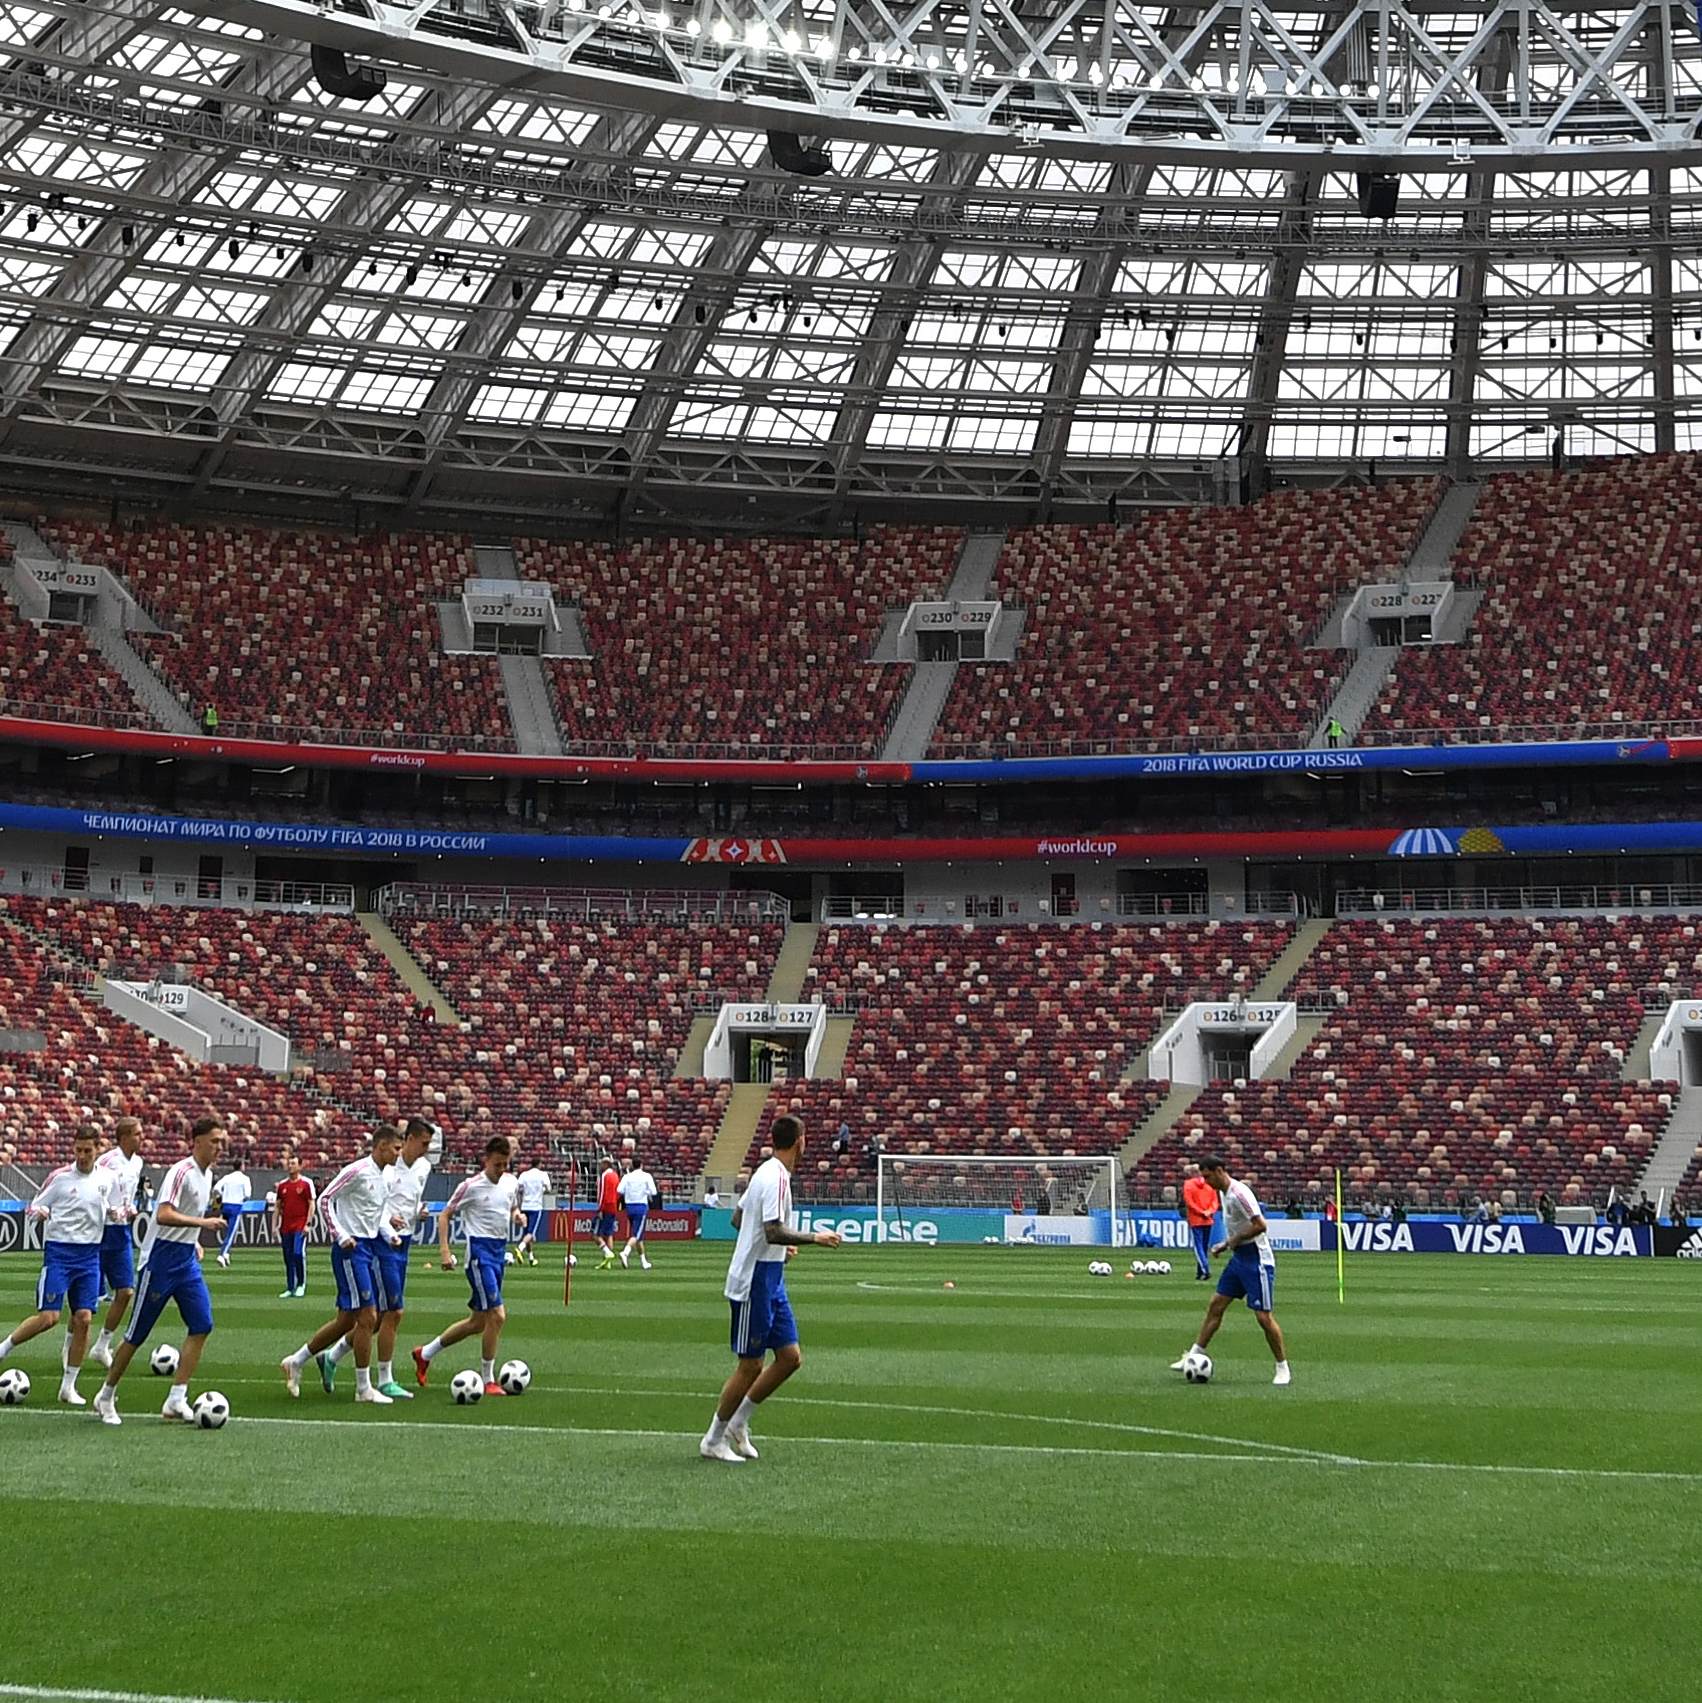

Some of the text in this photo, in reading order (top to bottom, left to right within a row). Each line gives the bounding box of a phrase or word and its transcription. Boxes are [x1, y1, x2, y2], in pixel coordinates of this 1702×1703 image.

[37, 570, 97, 586] 234 233
[1380, 595, 1403, 607] 228
[481, 605, 543, 617] 232 231
[930, 612, 992, 623] 230 229
[370, 753, 425, 767] #worldcup
[1143, 753, 1363, 772] 2018 FIFA WORLD CUP RUSSIA
[83, 814, 486, 851] ЧЕМПИОНАТ МИРА ПО ФУТБОЛУ FIFA 2018 В РОССИИ
[1037, 838, 1117, 856] #worldcup
[165, 992, 184, 1005] 129
[745, 1011, 813, 1023] 128 127
[1213, 1010, 1237, 1022] 126
[1336, 1222, 1414, 1252] VISA
[1444, 1223, 1526, 1254] VISA
[1554, 1225, 1638, 1257] VISA
